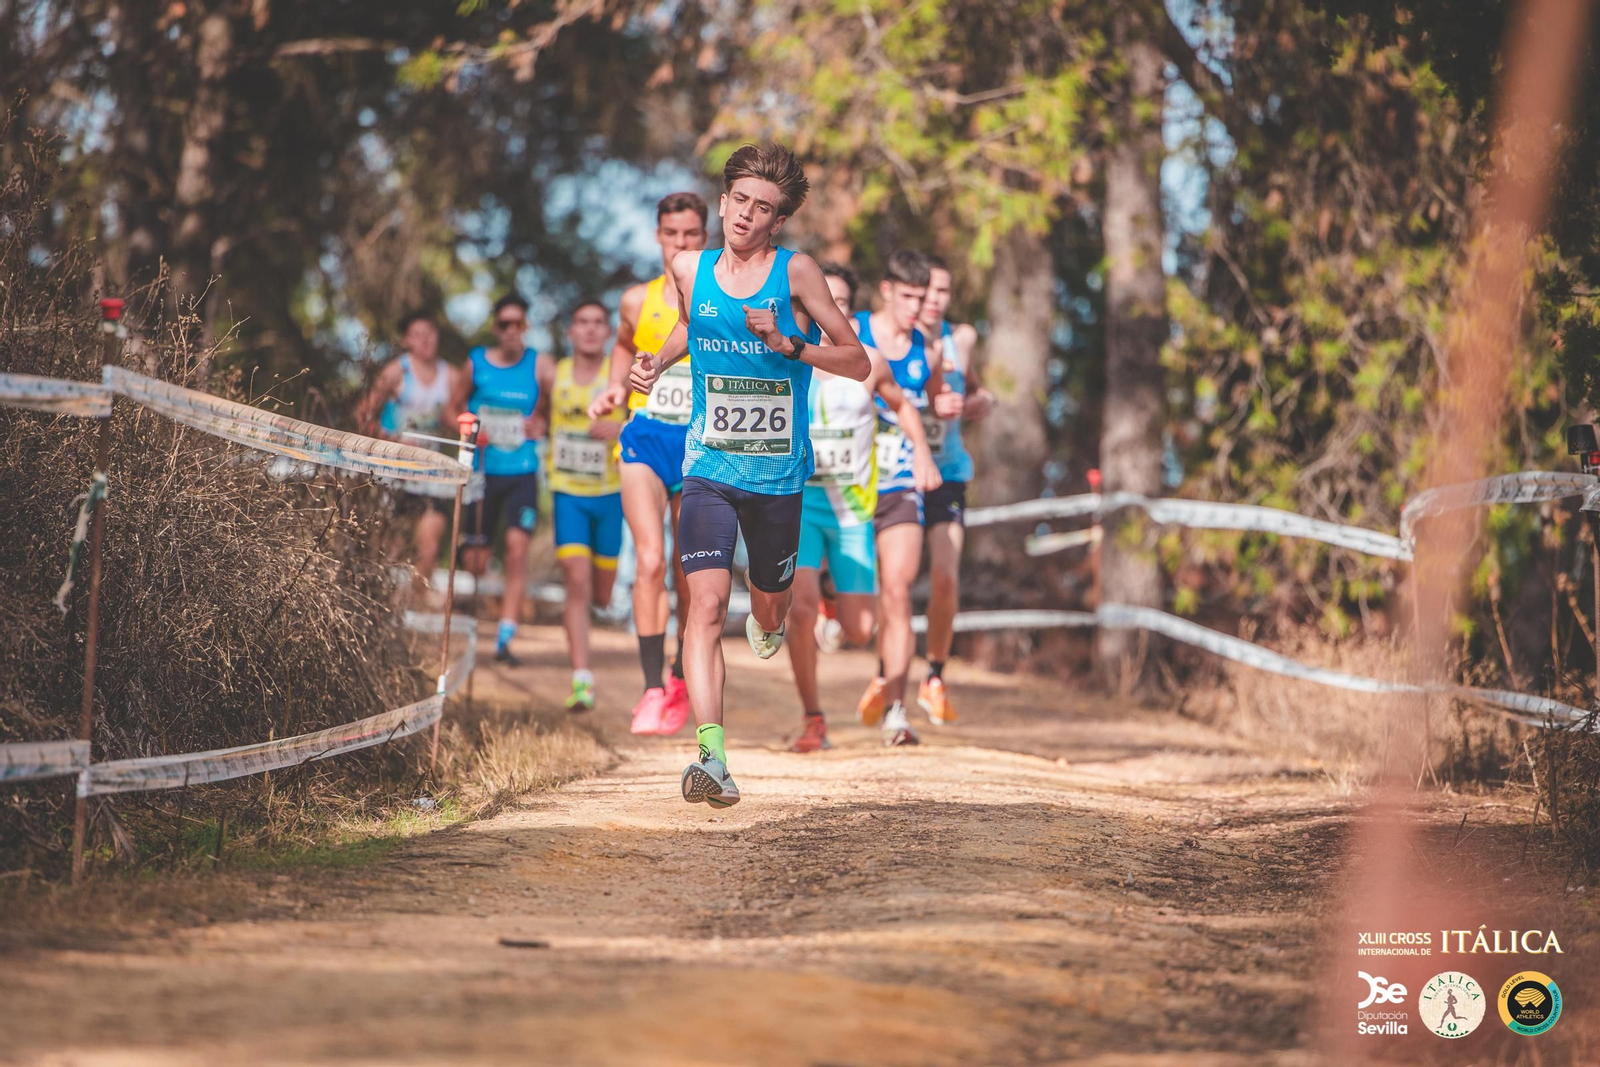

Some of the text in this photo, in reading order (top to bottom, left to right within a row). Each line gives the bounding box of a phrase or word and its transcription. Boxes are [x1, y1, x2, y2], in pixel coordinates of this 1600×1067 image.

[698, 299, 718, 317] als
[728, 379, 770, 391] ITÁLICA
[713, 406, 787, 433] 8226
